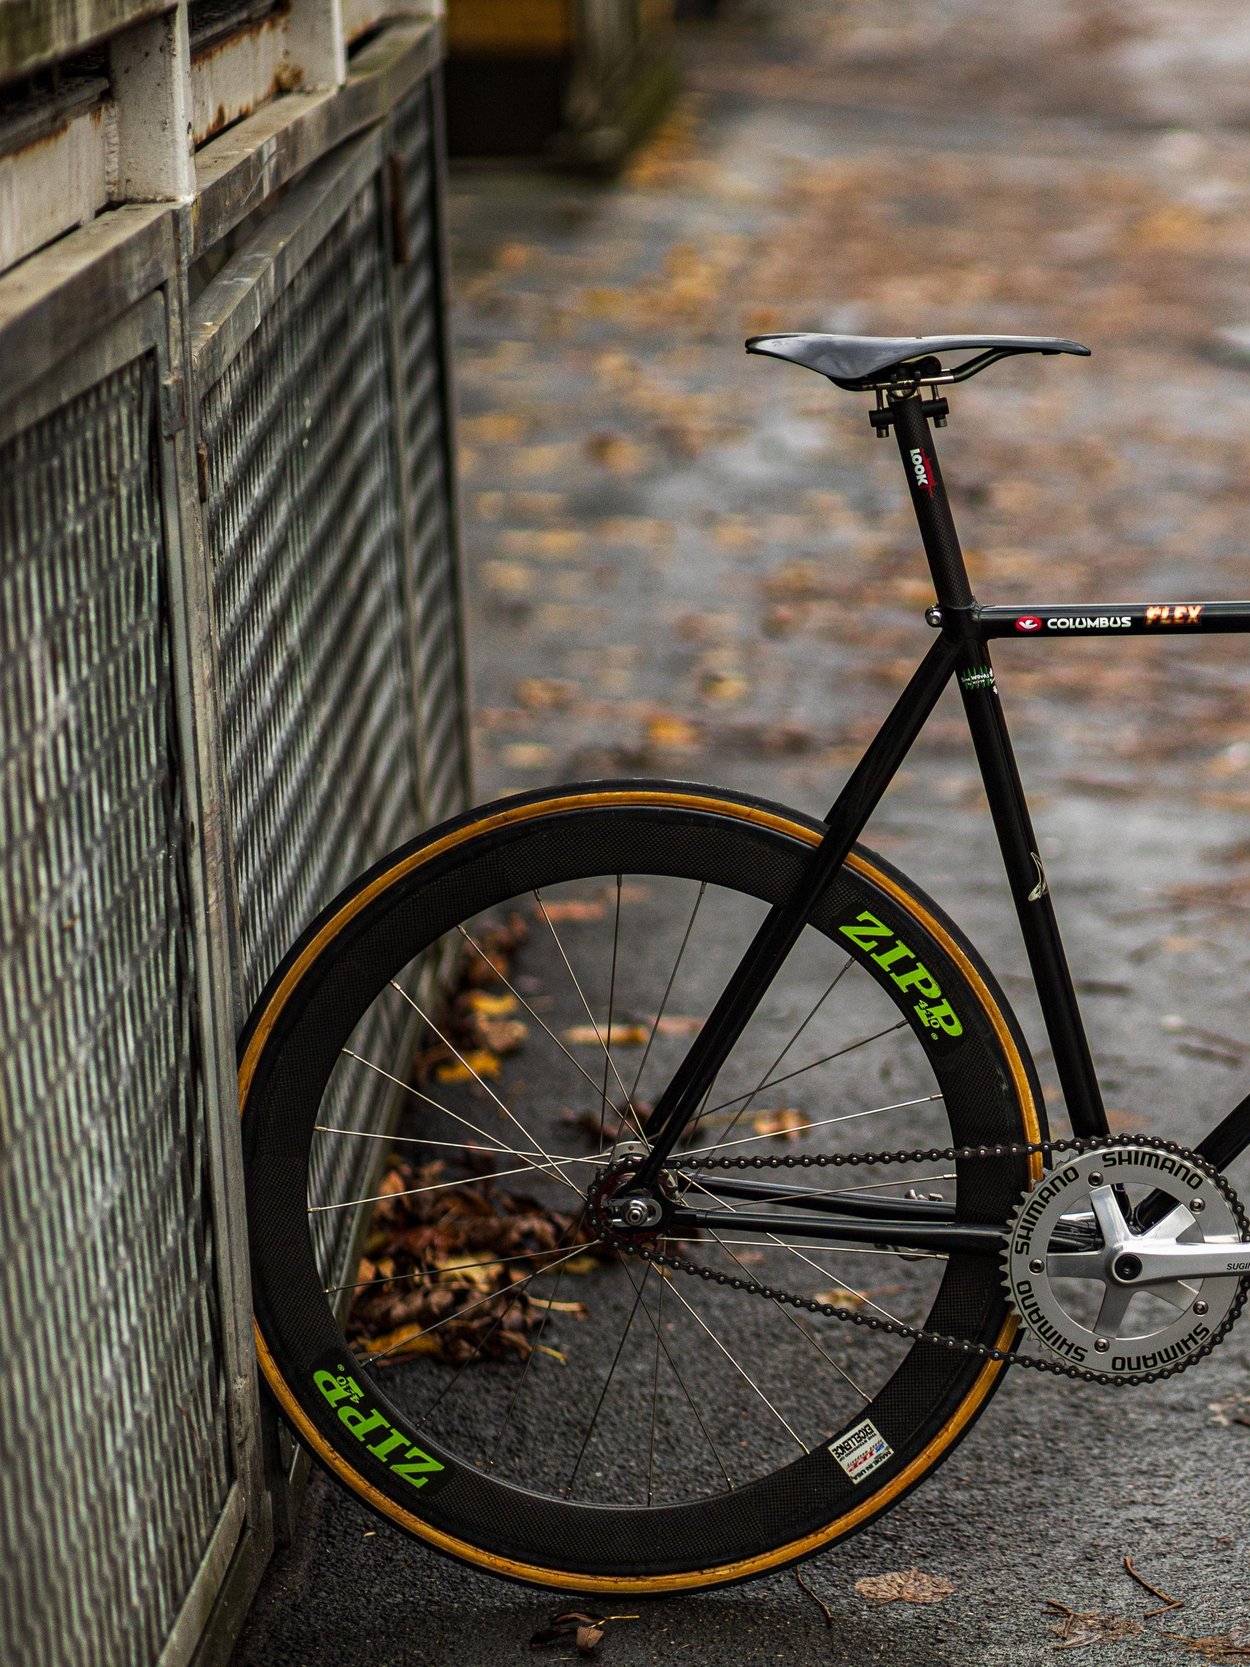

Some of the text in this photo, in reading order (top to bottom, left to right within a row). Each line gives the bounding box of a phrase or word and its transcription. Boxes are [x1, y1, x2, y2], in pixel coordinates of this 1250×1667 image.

[910, 448, 928, 486] LOOK
[1046, 616, 1132, 630] COLUMBUS
[1144, 605, 1202, 624] FLEX
[838, 910, 963, 1037] ZIPP
[1101, 1150, 1204, 1190] SHIMANO
[1014, 1165, 1080, 1255] SHIMANO
[1016, 1279, 1089, 1363] SHIMANO
[1111, 1322, 1211, 1372] SHIMANO
[313, 1369, 445, 1489] ZIPP
[831, 1423, 874, 1459] EXCELLENCE
